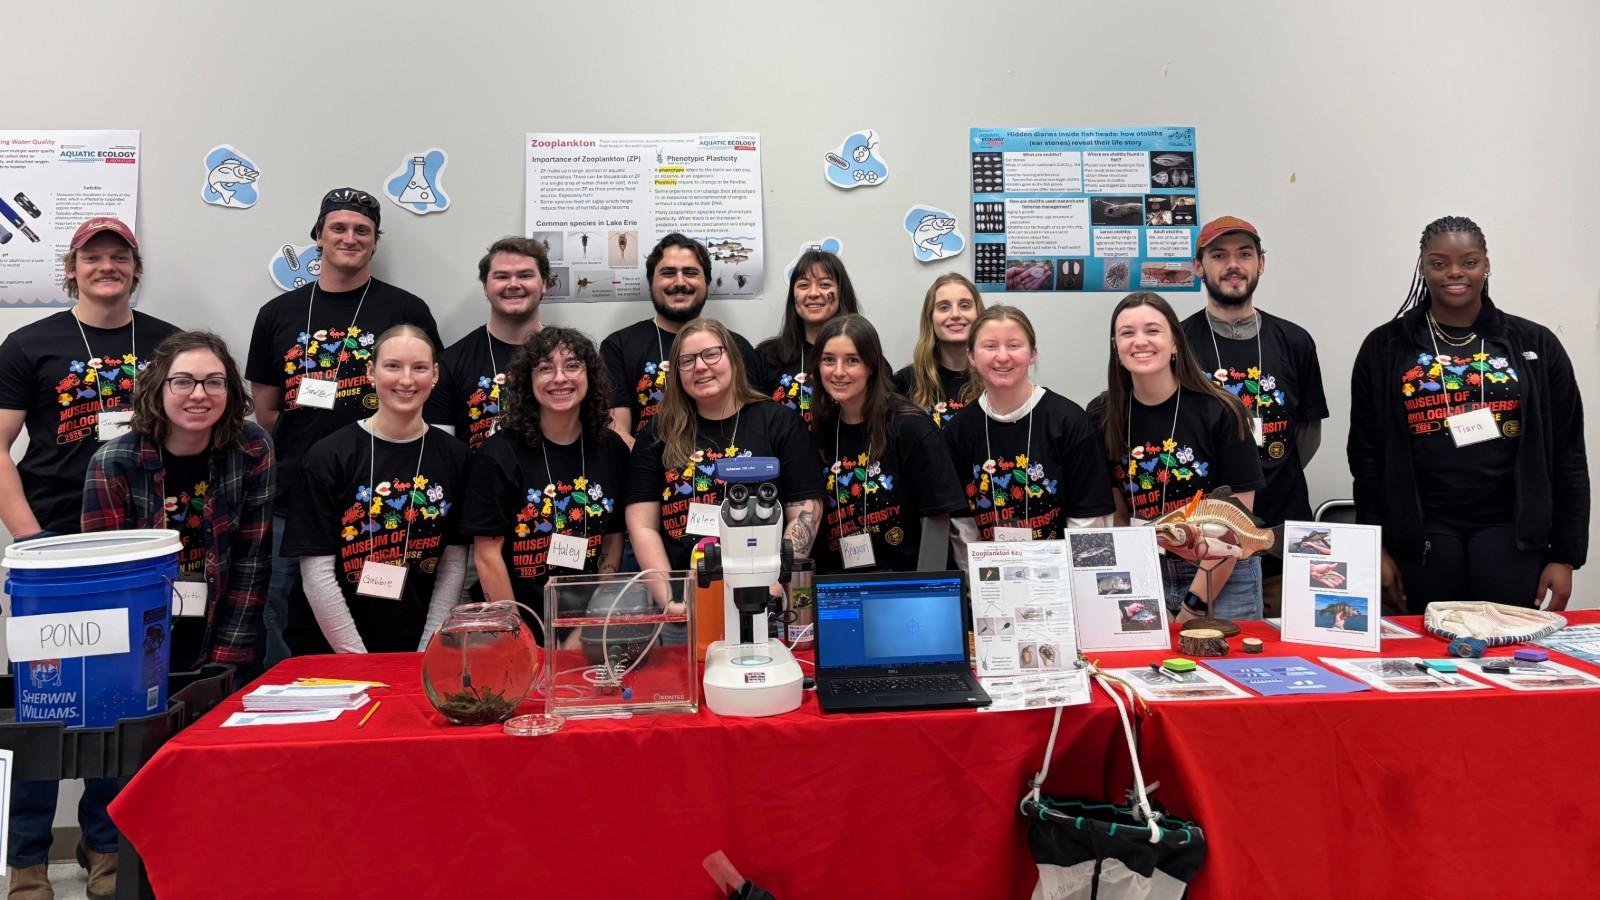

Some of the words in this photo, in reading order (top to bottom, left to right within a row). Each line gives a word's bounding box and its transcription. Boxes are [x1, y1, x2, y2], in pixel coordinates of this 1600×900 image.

[531, 139, 596, 149] Zooplankton
[1404, 393, 1451, 410] MUSEUM
[1454, 391, 1470, 401] OF
[60, 401, 101, 421] MUSEUM
[107, 396, 121, 408] OF
[1262, 420, 1288, 433] RSITY
[1454, 423, 1483, 435] Tiara
[703, 493, 717, 504] OF
[1148, 490, 1160, 502] OF
[1002, 507, 1014, 519] OF
[342, 534, 388, 558] MUSEUM
[391, 529, 406, 543] OF
[514, 536, 550, 551] MUSEU
[552, 541, 580, 562] Haley
[972, 550, 1010, 558] Zooplankton
[514, 553, 548, 566] BIOLOG
[363, 576, 392, 588] Gabbie
[40, 621, 101, 648] POND
[22, 690, 77, 704] SHERWIN
